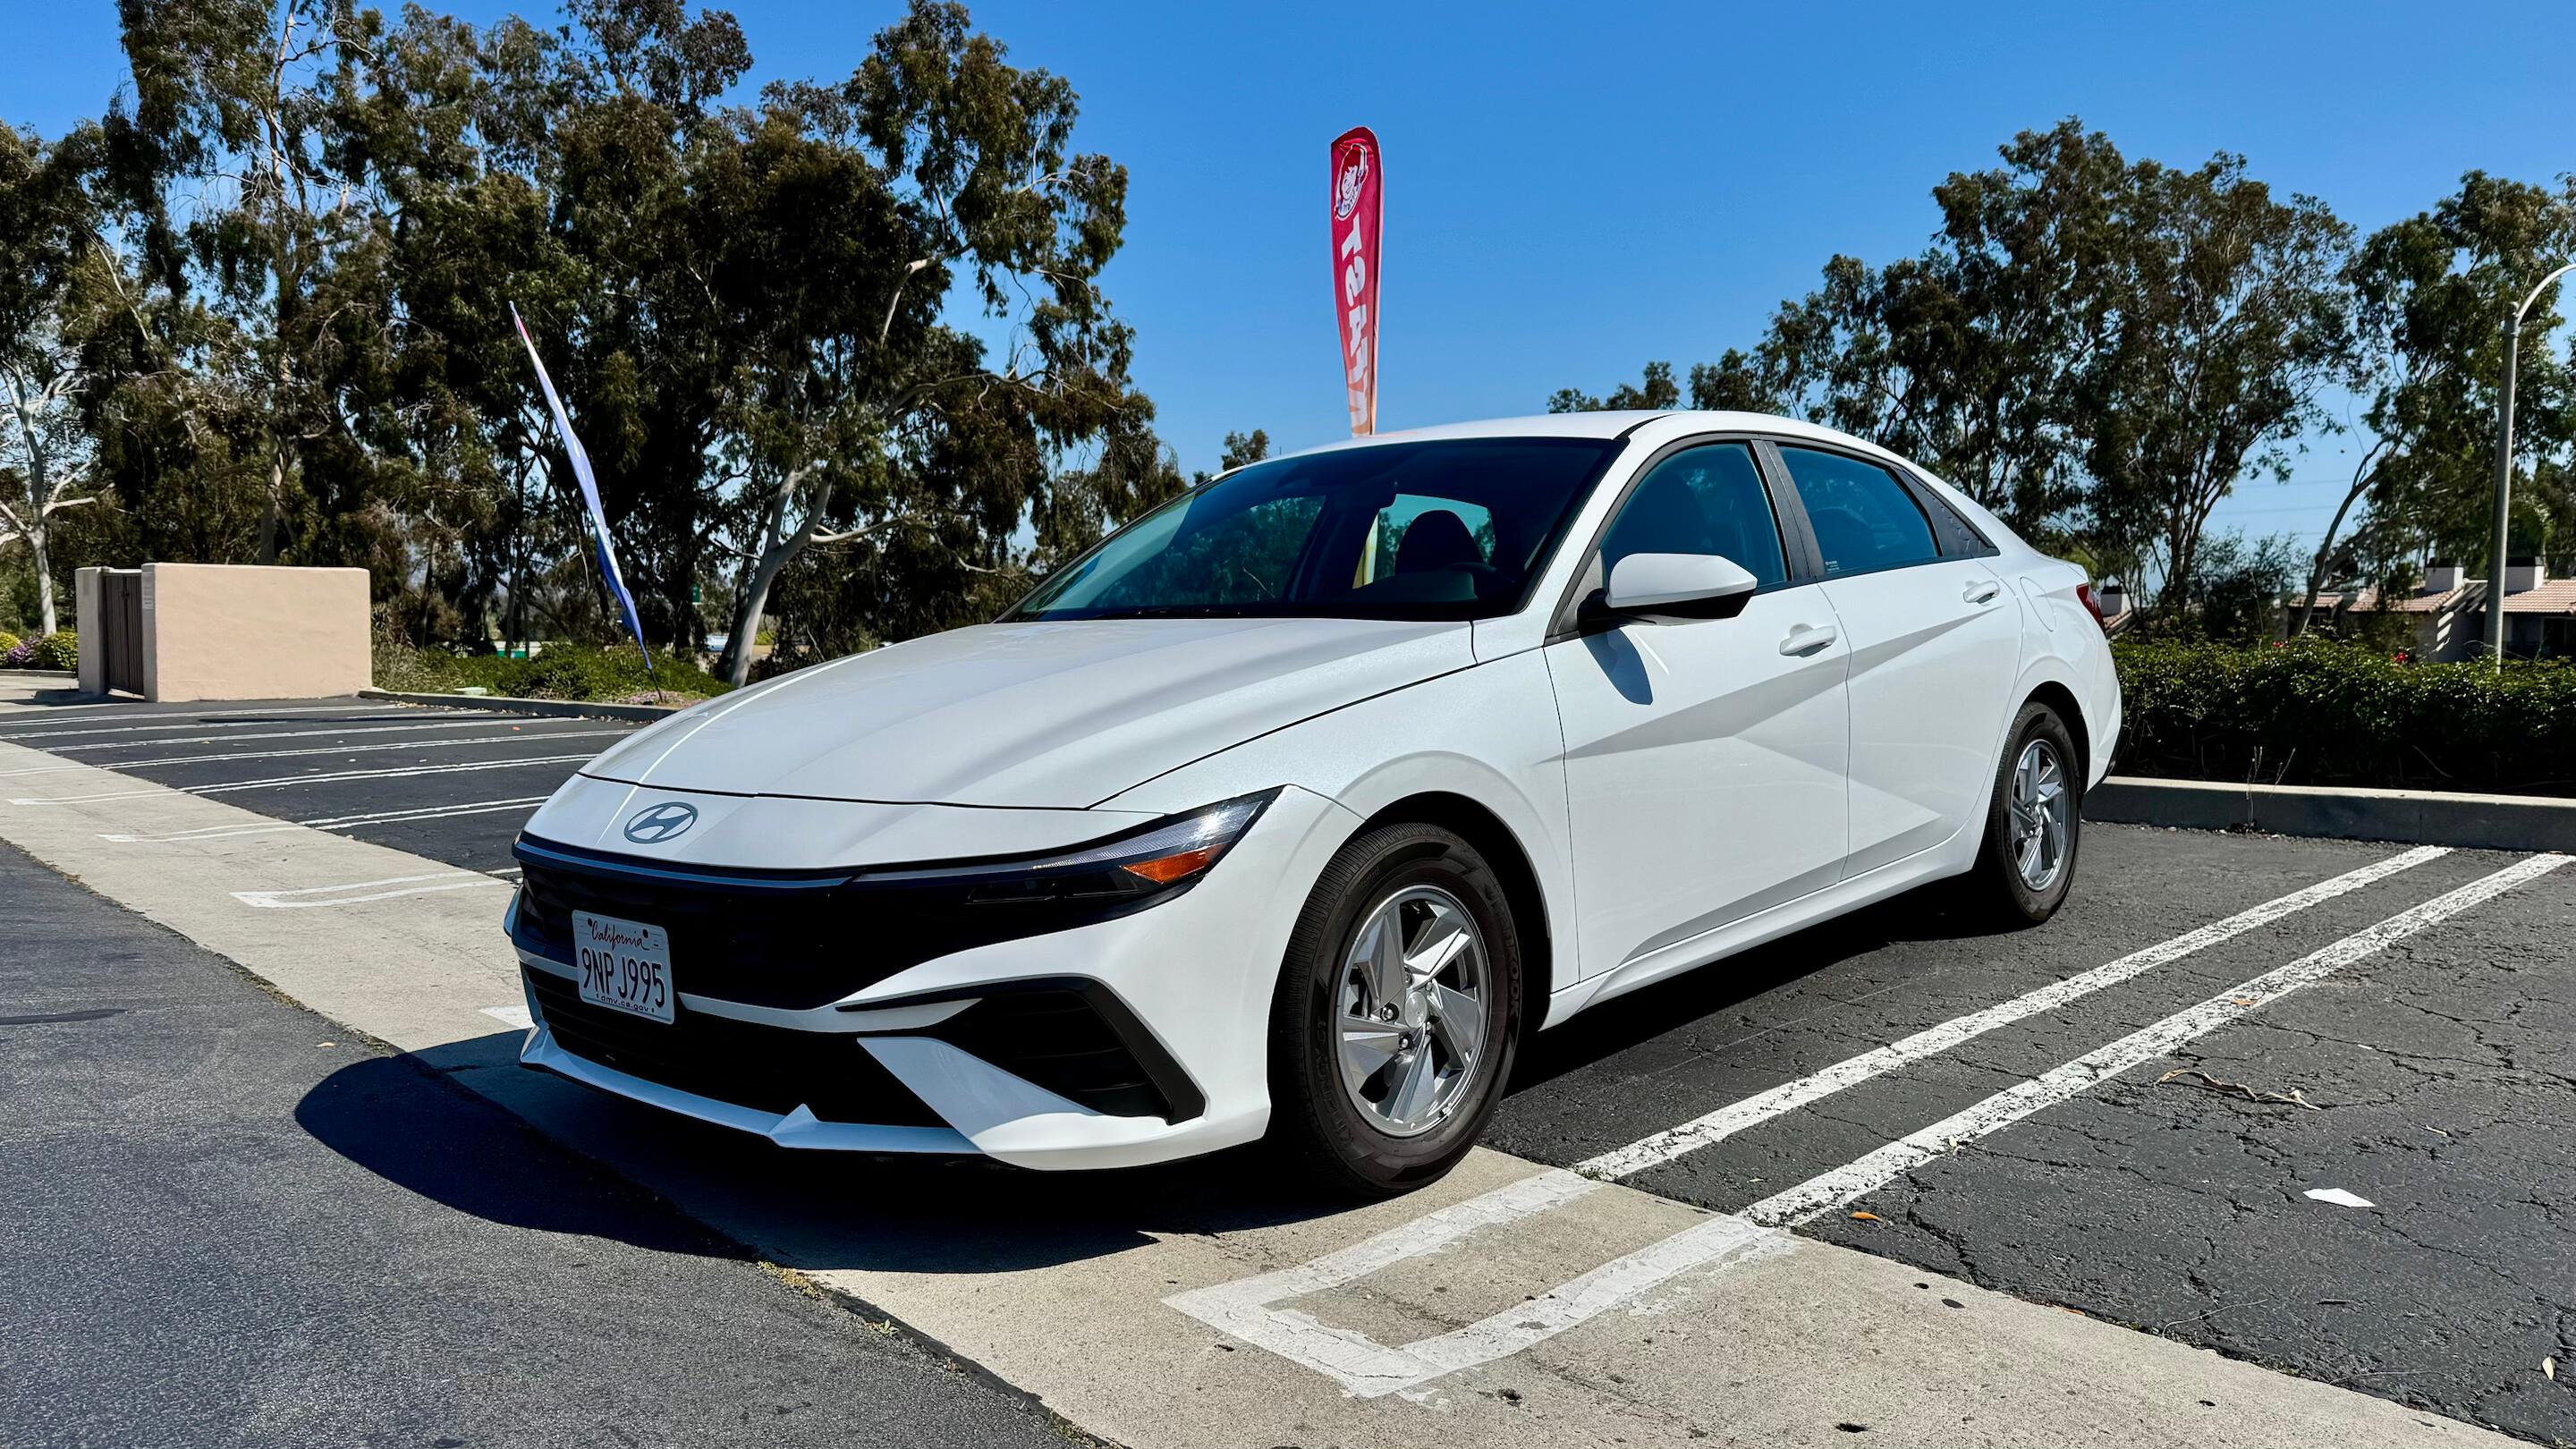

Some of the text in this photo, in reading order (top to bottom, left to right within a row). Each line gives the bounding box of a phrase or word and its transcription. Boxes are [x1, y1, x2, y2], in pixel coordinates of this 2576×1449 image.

[590, 919, 650, 951] California
[581, 947, 665, 1008] 9NPJ995
[601, 996, 649, 1012] dmv.ca.gov
